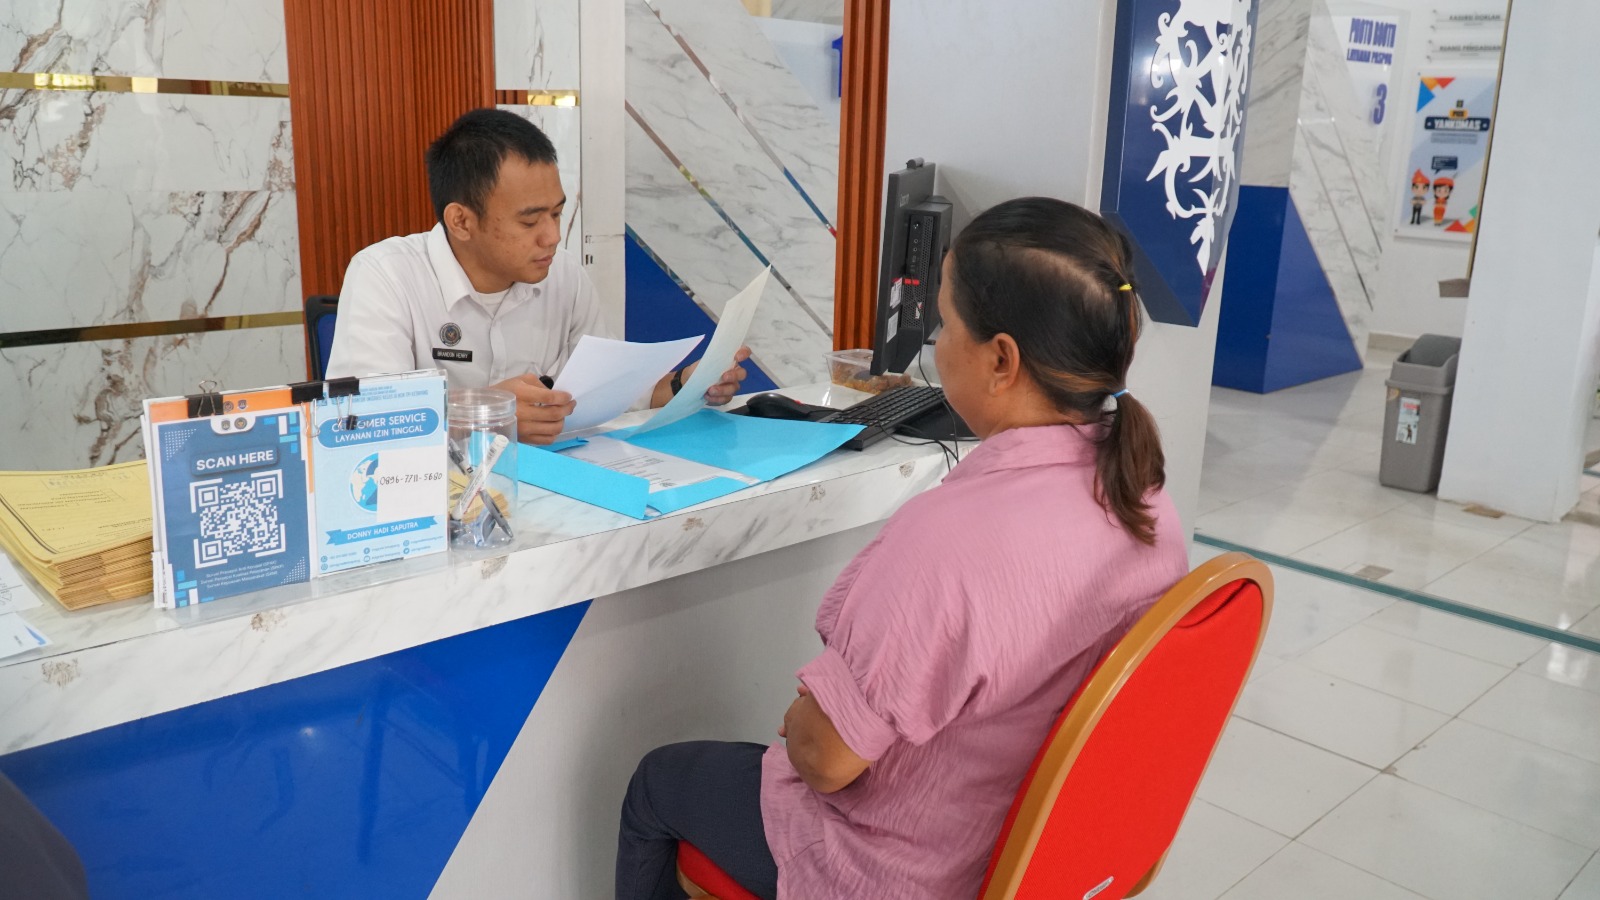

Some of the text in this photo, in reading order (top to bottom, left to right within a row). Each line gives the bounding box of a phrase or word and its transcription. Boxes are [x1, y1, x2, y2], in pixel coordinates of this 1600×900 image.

[1373, 83, 1387, 125] 3
[1433, 119, 1482, 131] YANKOMAS
[437, 350, 455, 358] BRANDON
[331, 412, 427, 433] COMER SERVICE
[335, 425, 424, 443] LAYANAN IZIN TINGGAL
[196, 449, 274, 471] SCAN HERE
[347, 521, 419, 540] DONNY HADI SAPUTRA
